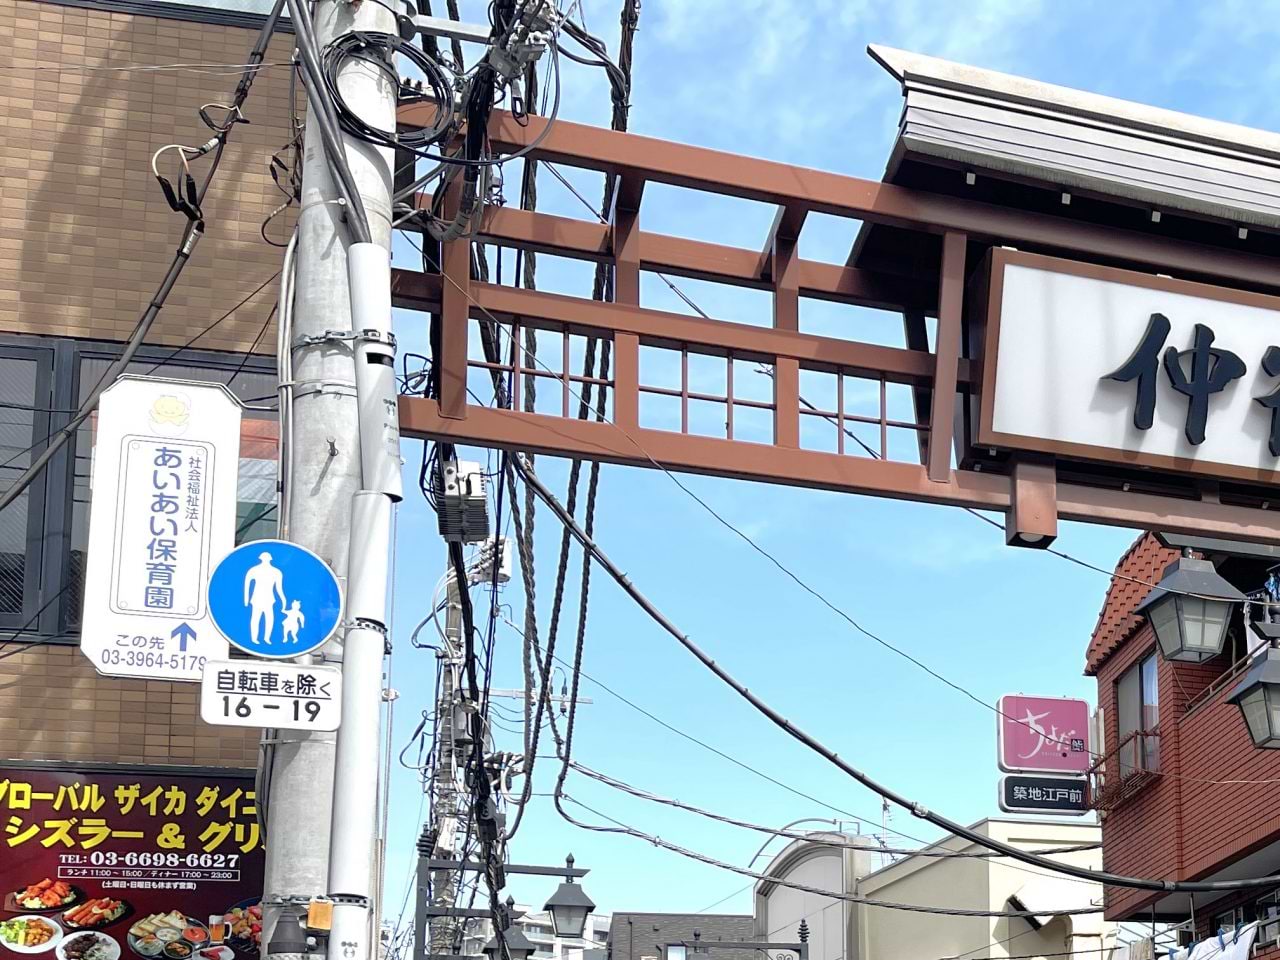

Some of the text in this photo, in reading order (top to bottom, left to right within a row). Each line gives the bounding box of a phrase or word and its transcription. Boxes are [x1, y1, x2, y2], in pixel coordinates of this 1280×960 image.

[184, 456, 202, 533] 社会福祉法人
[145, 447, 182, 609] あいあい保育園
[116, 635, 165, 650] この先
[102, 649, 207, 673] 03-3964-5179
[217, 670, 331, 697] 自転車を除く
[114, 783, 187, 816] ザイカ
[1013, 785, 1082, 803] 築地江戸前
[5, 815, 265, 853] シズラー & グリ
[59, 851, 240, 868] TEL: 03-6698-6627
